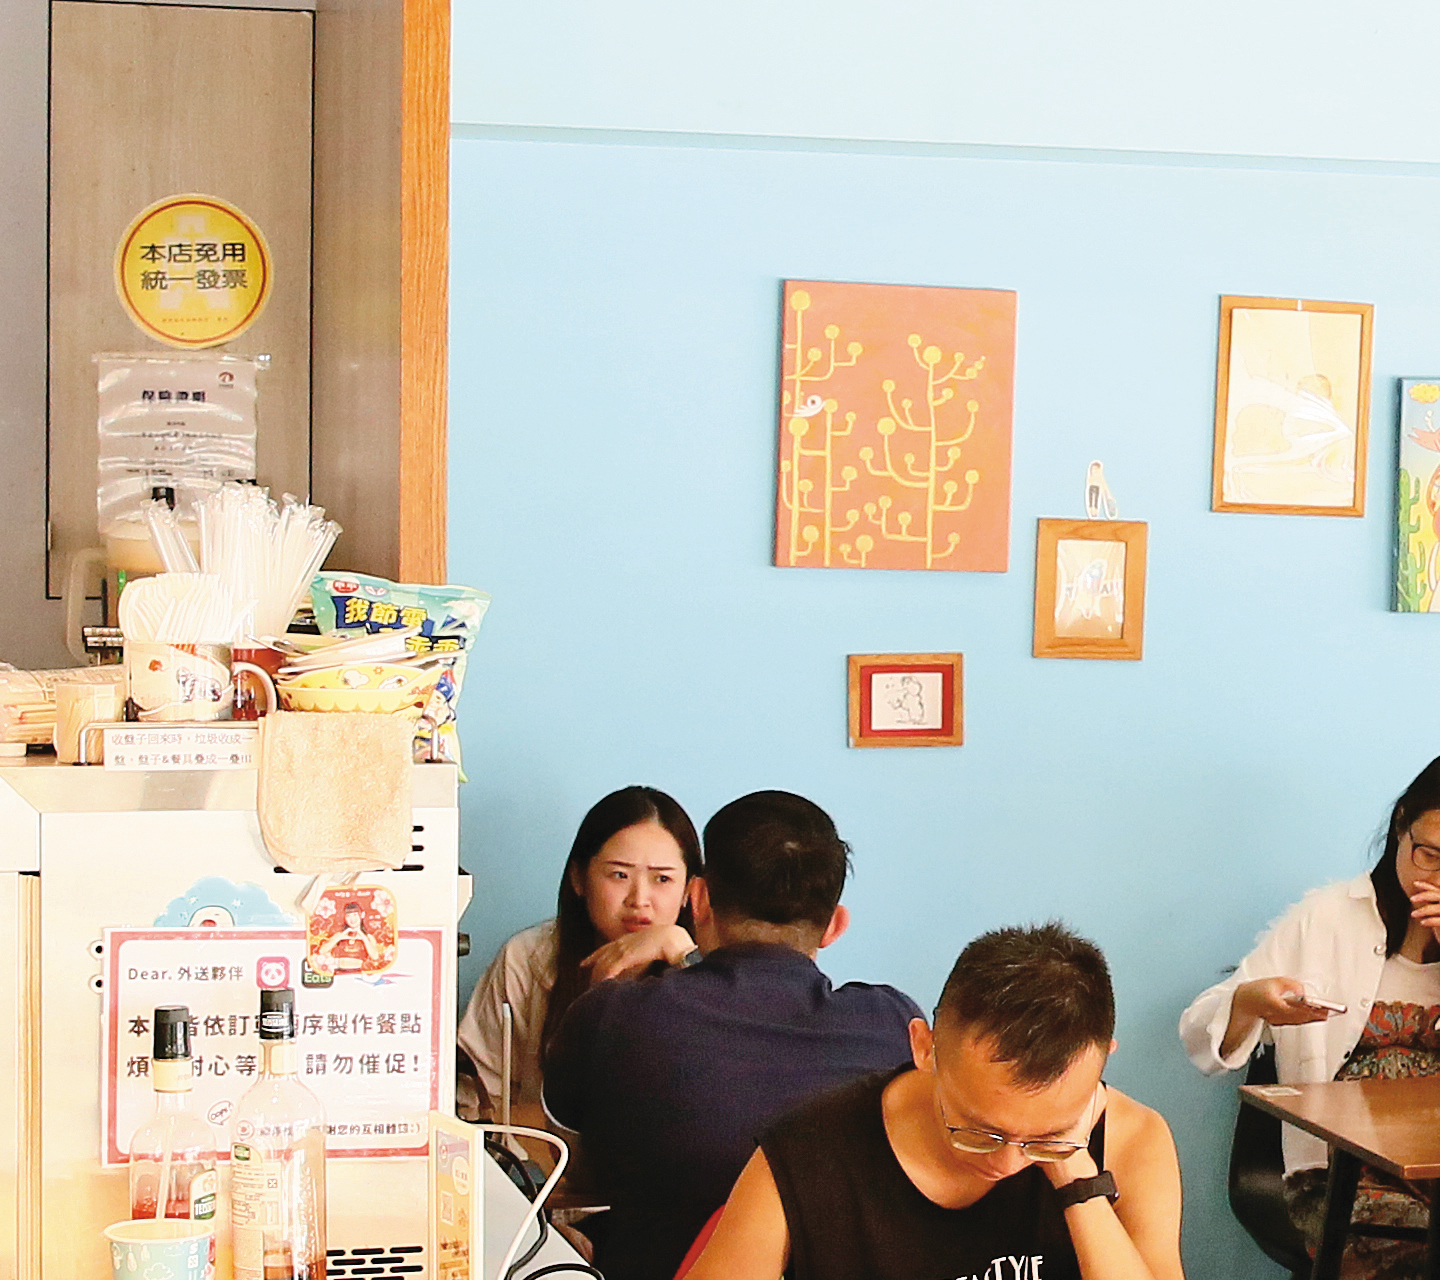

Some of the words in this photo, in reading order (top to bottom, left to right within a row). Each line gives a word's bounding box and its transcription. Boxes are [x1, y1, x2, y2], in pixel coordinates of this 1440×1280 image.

[139, 242, 246, 263] 本店免用
[140, 268, 248, 290] 統一發票
[345, 597, 427, 628] 我節電
[128, 966, 172, 981] Dear.
[177, 965, 244, 981] 外送夥伴
